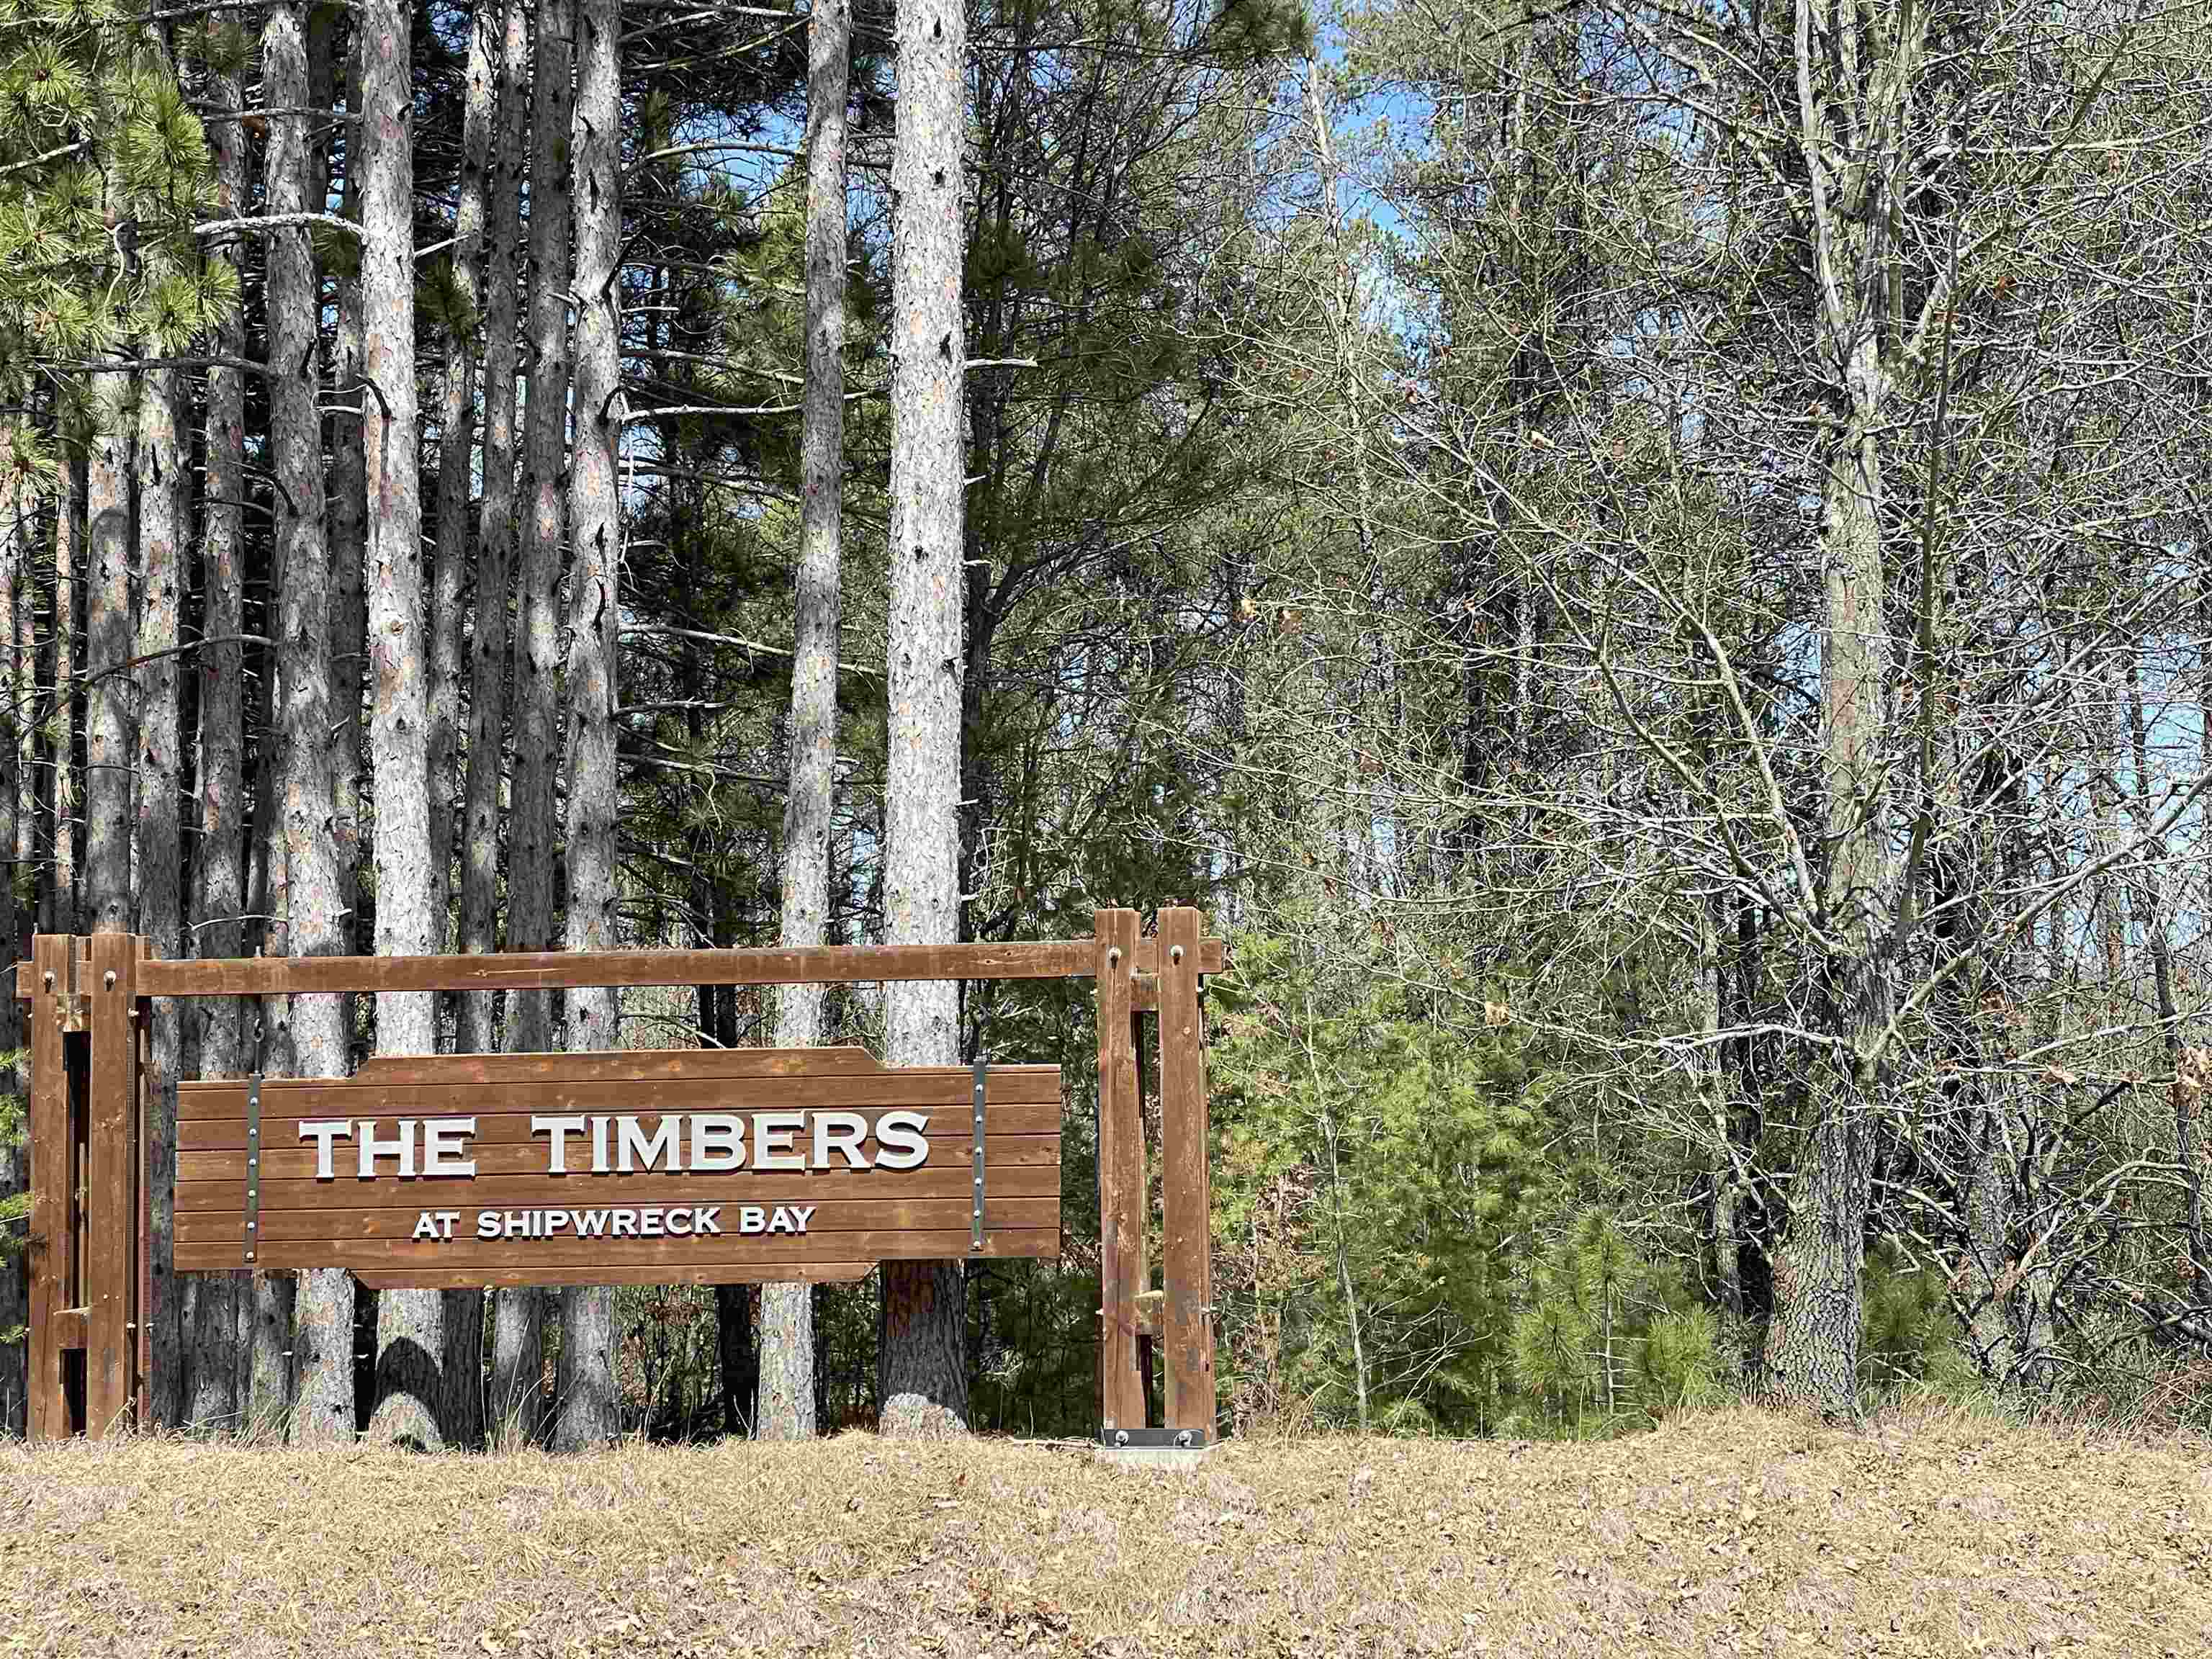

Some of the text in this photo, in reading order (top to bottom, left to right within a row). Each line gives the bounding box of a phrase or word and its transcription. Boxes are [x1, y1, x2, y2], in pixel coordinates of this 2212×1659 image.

[298, 1110, 930, 1181] THE TIMBERS
[413, 1205, 816, 1240] AT SHIPWRECK BAY
